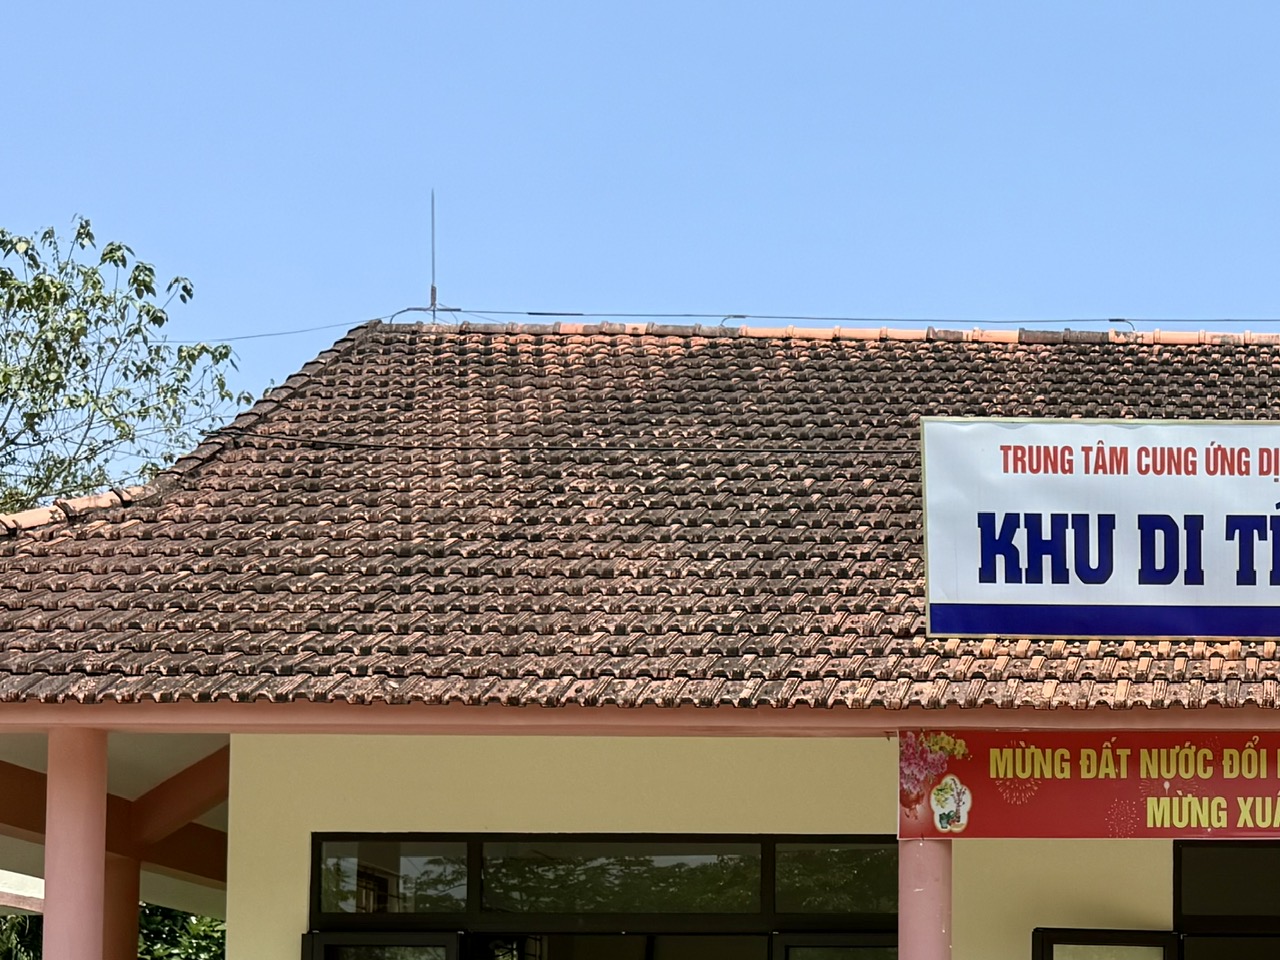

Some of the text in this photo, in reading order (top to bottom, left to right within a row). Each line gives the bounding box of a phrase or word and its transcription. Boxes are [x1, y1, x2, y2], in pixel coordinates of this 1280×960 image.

[1000, 445, 1073, 475] TRUNG
[1081, 440, 1128, 475] TÂM
[1137, 447, 1197, 476] CUNG
[1205, 441, 1250, 476] ỨNG
[977, 513, 1115, 585] KHU
[1138, 514, 1204, 586] DI
[990, 741, 1070, 779] MỪNG
[1080, 737, 1131, 779] ĐẤT
[1140, 741, 1213, 779] NƯỚC
[1222, 735, 1267, 779] ĐỔI
[1146, 790, 1228, 828] MỪNG
